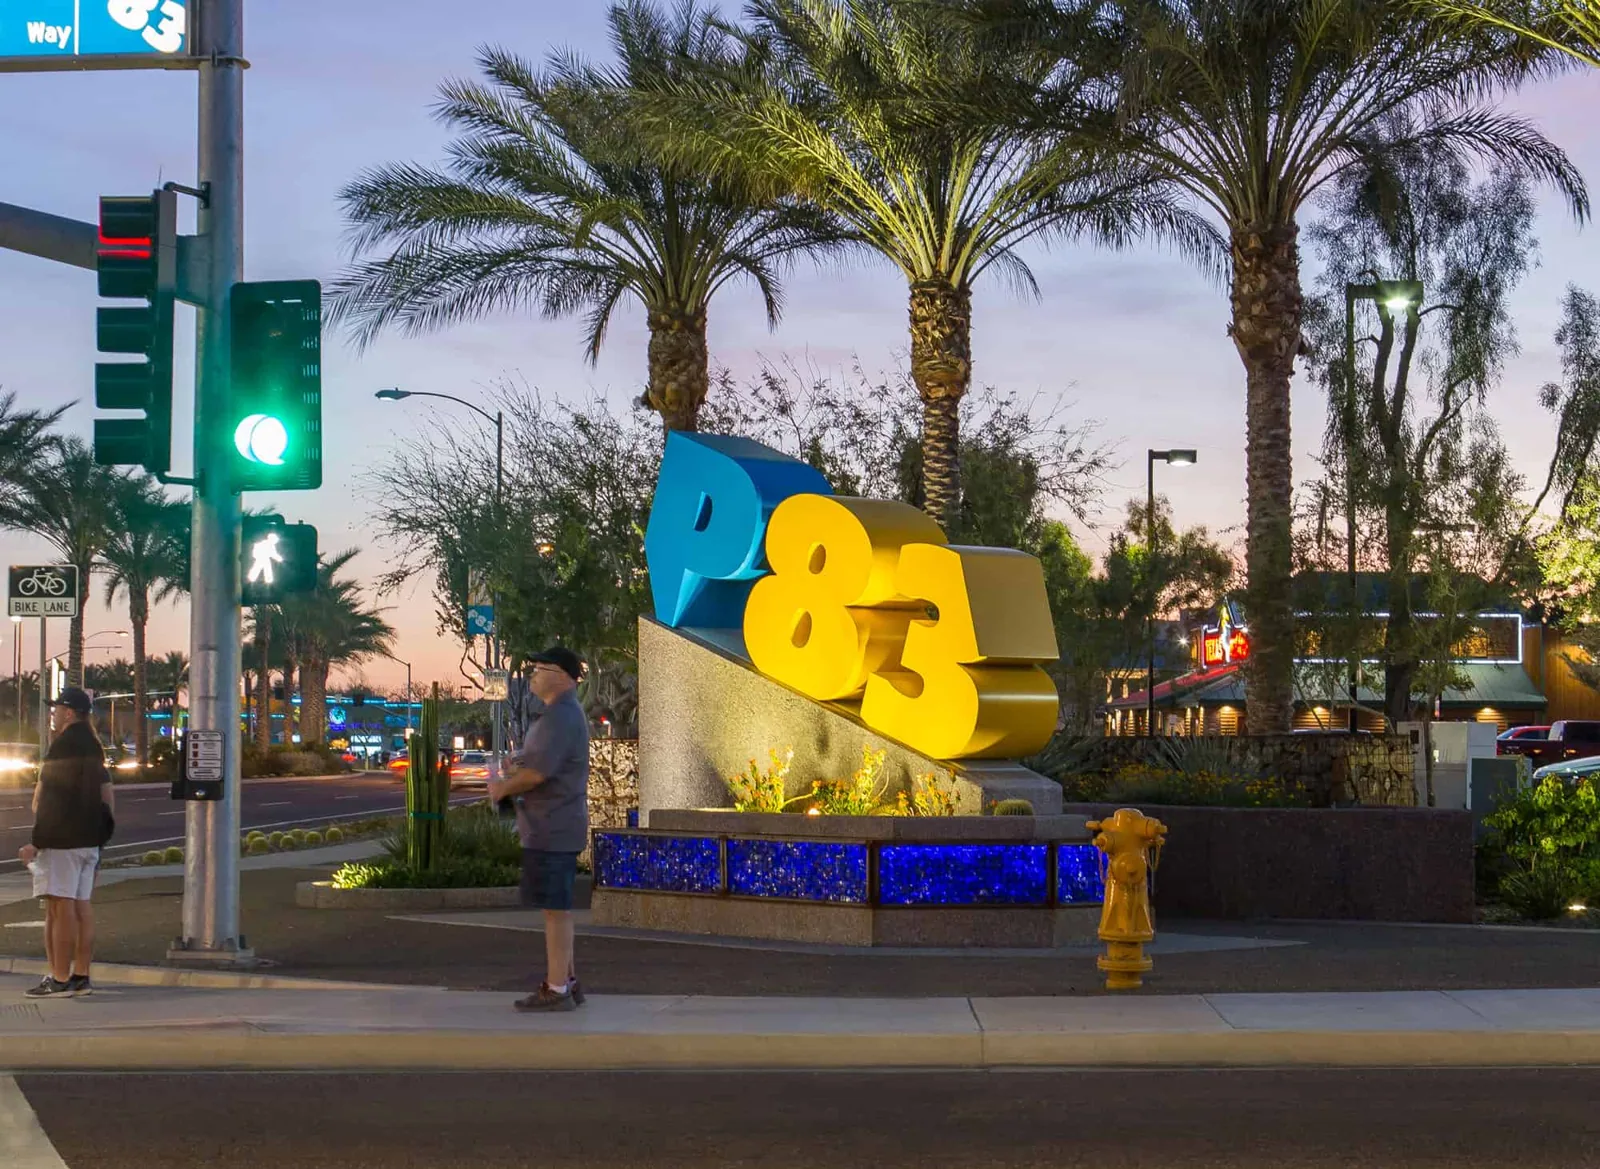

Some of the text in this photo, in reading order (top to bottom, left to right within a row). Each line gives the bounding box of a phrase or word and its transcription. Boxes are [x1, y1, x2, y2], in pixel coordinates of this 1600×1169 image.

[27, 22, 72, 49] Way
[14, 601, 71, 612] BIKE LANE
[645, 429, 1059, 761] P83
